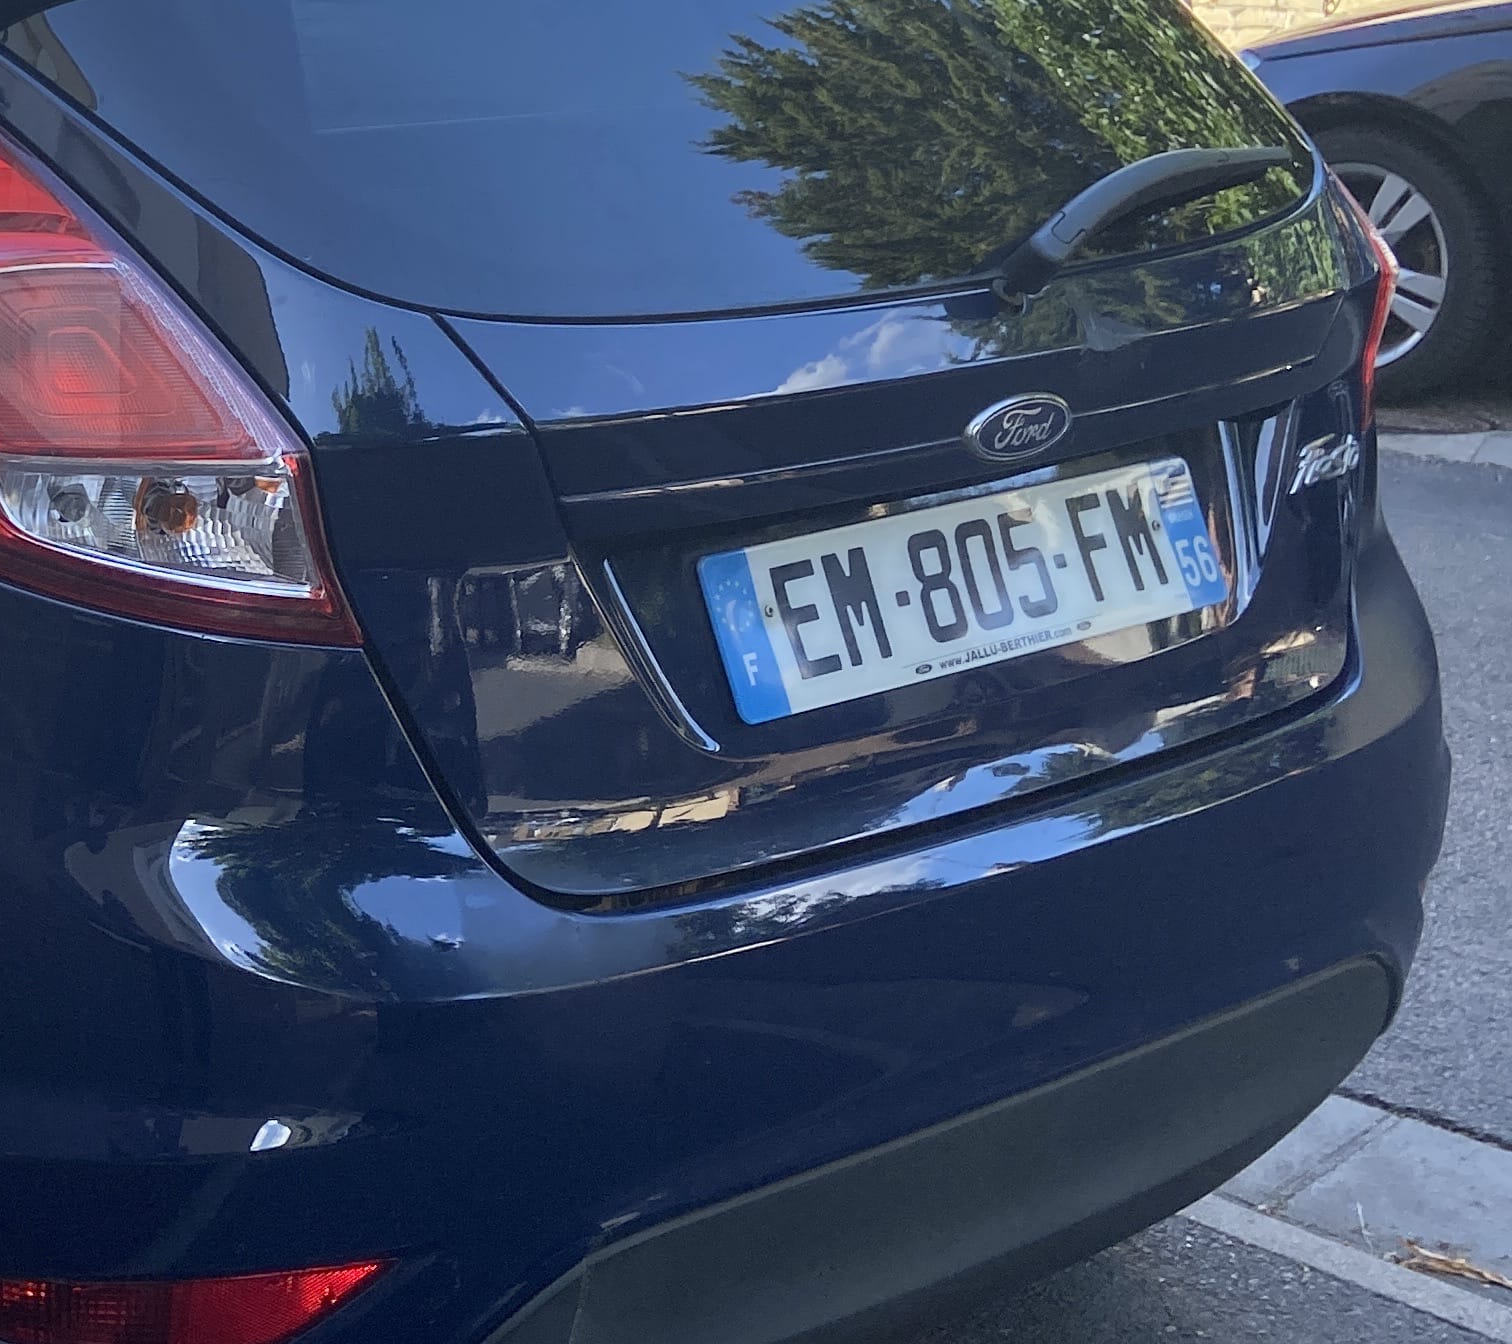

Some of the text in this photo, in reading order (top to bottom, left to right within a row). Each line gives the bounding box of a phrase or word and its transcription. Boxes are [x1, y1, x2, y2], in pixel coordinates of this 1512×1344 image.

[994, 407, 1055, 449] Ford
[1175, 535, 1218, 587] 56
[742, 652, 759, 687] F
